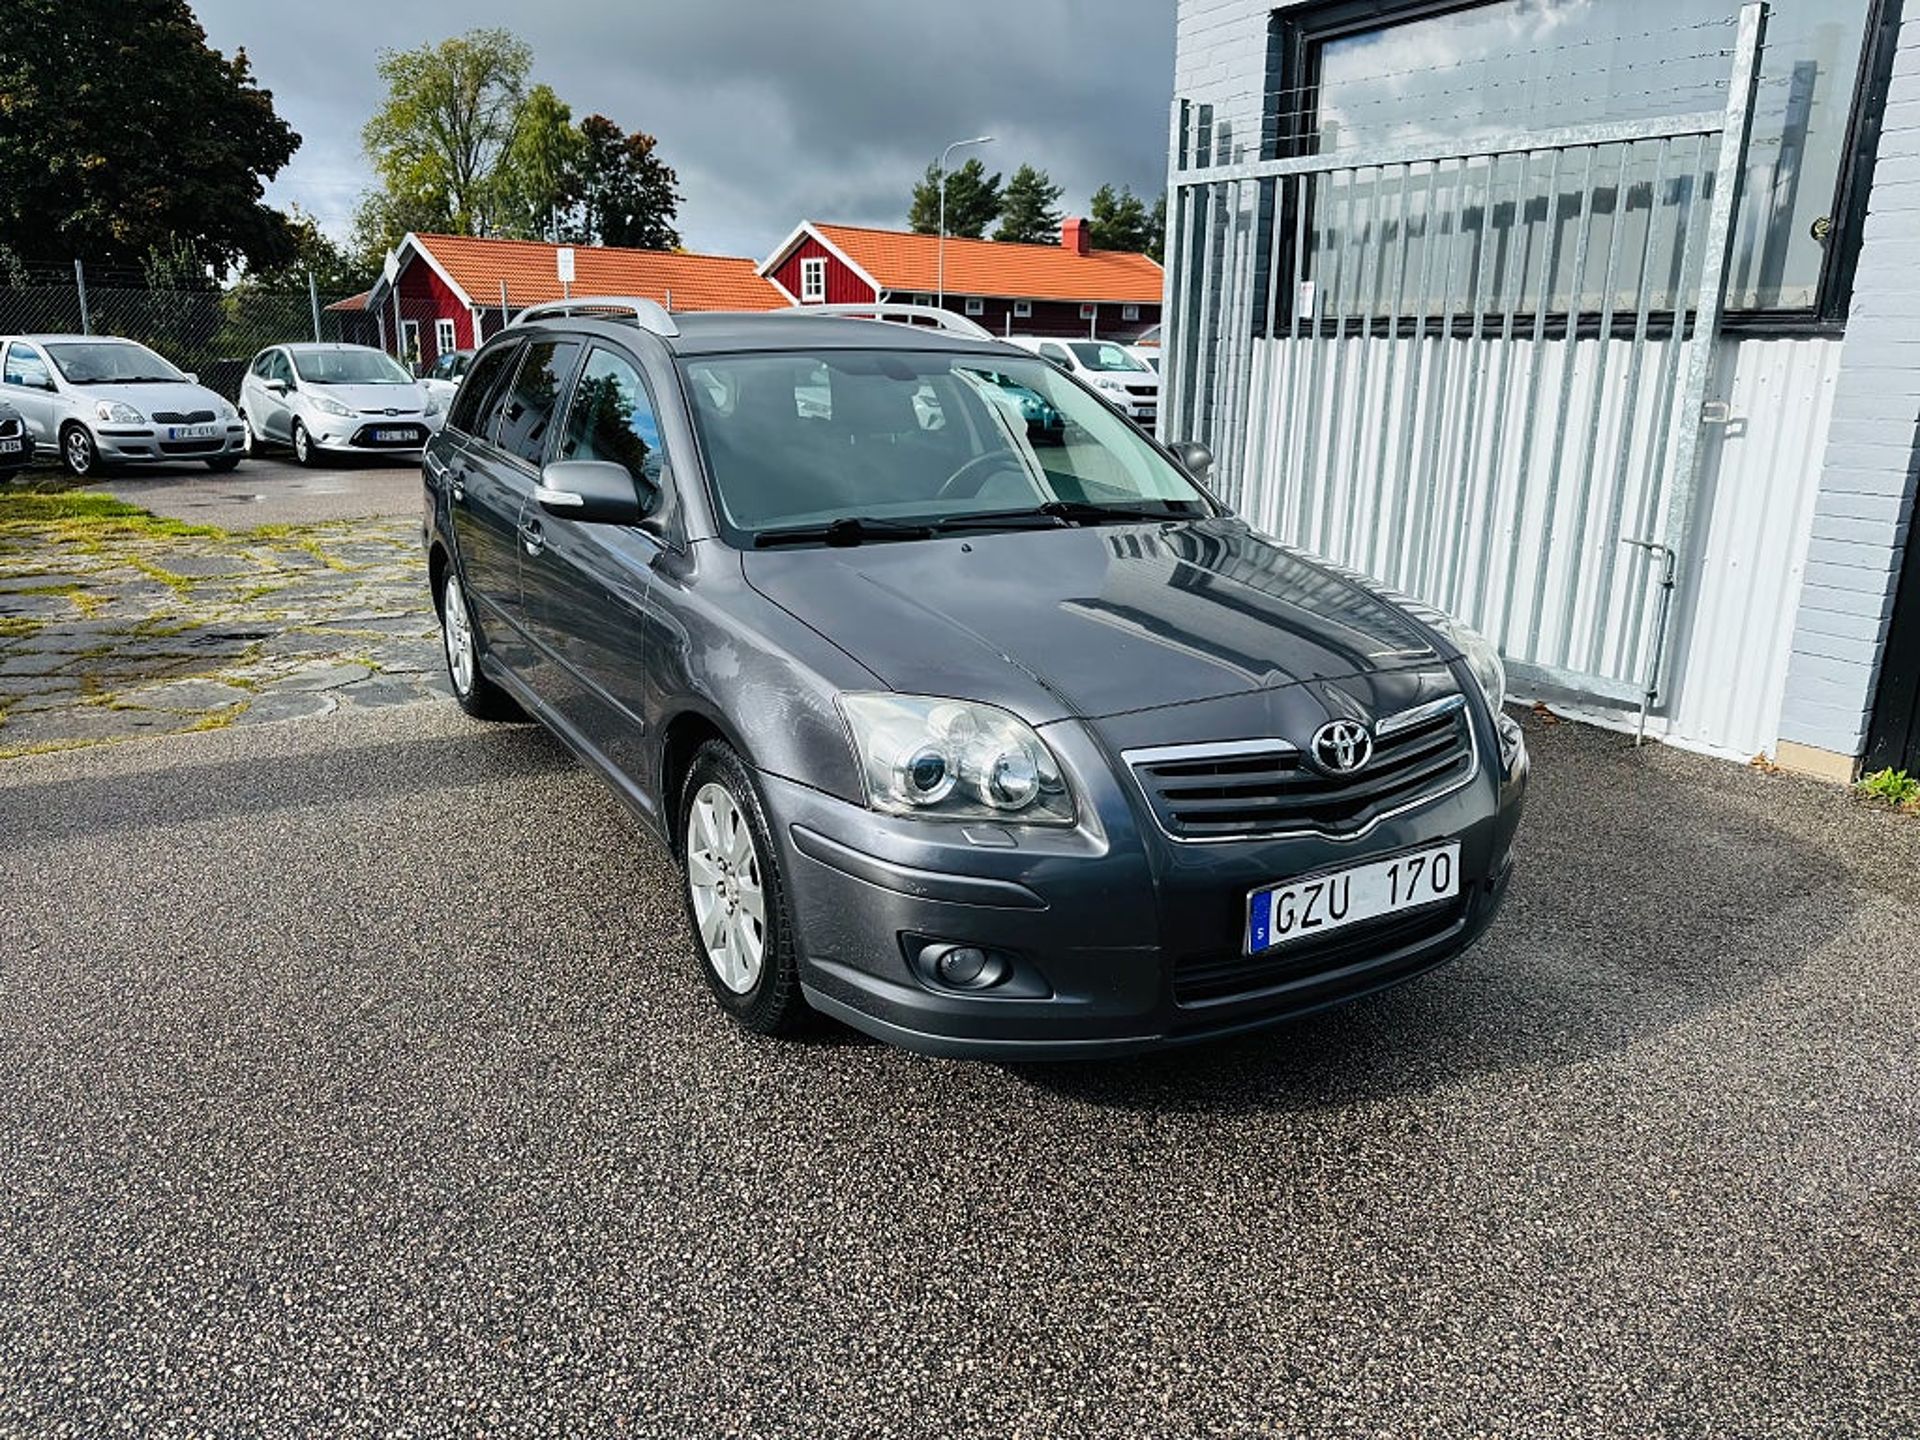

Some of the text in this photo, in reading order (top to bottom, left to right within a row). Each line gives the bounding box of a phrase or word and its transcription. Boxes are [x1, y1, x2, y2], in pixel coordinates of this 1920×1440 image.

[1276, 852, 1450, 934] GZU 170
[1256, 927, 1265, 940] S
